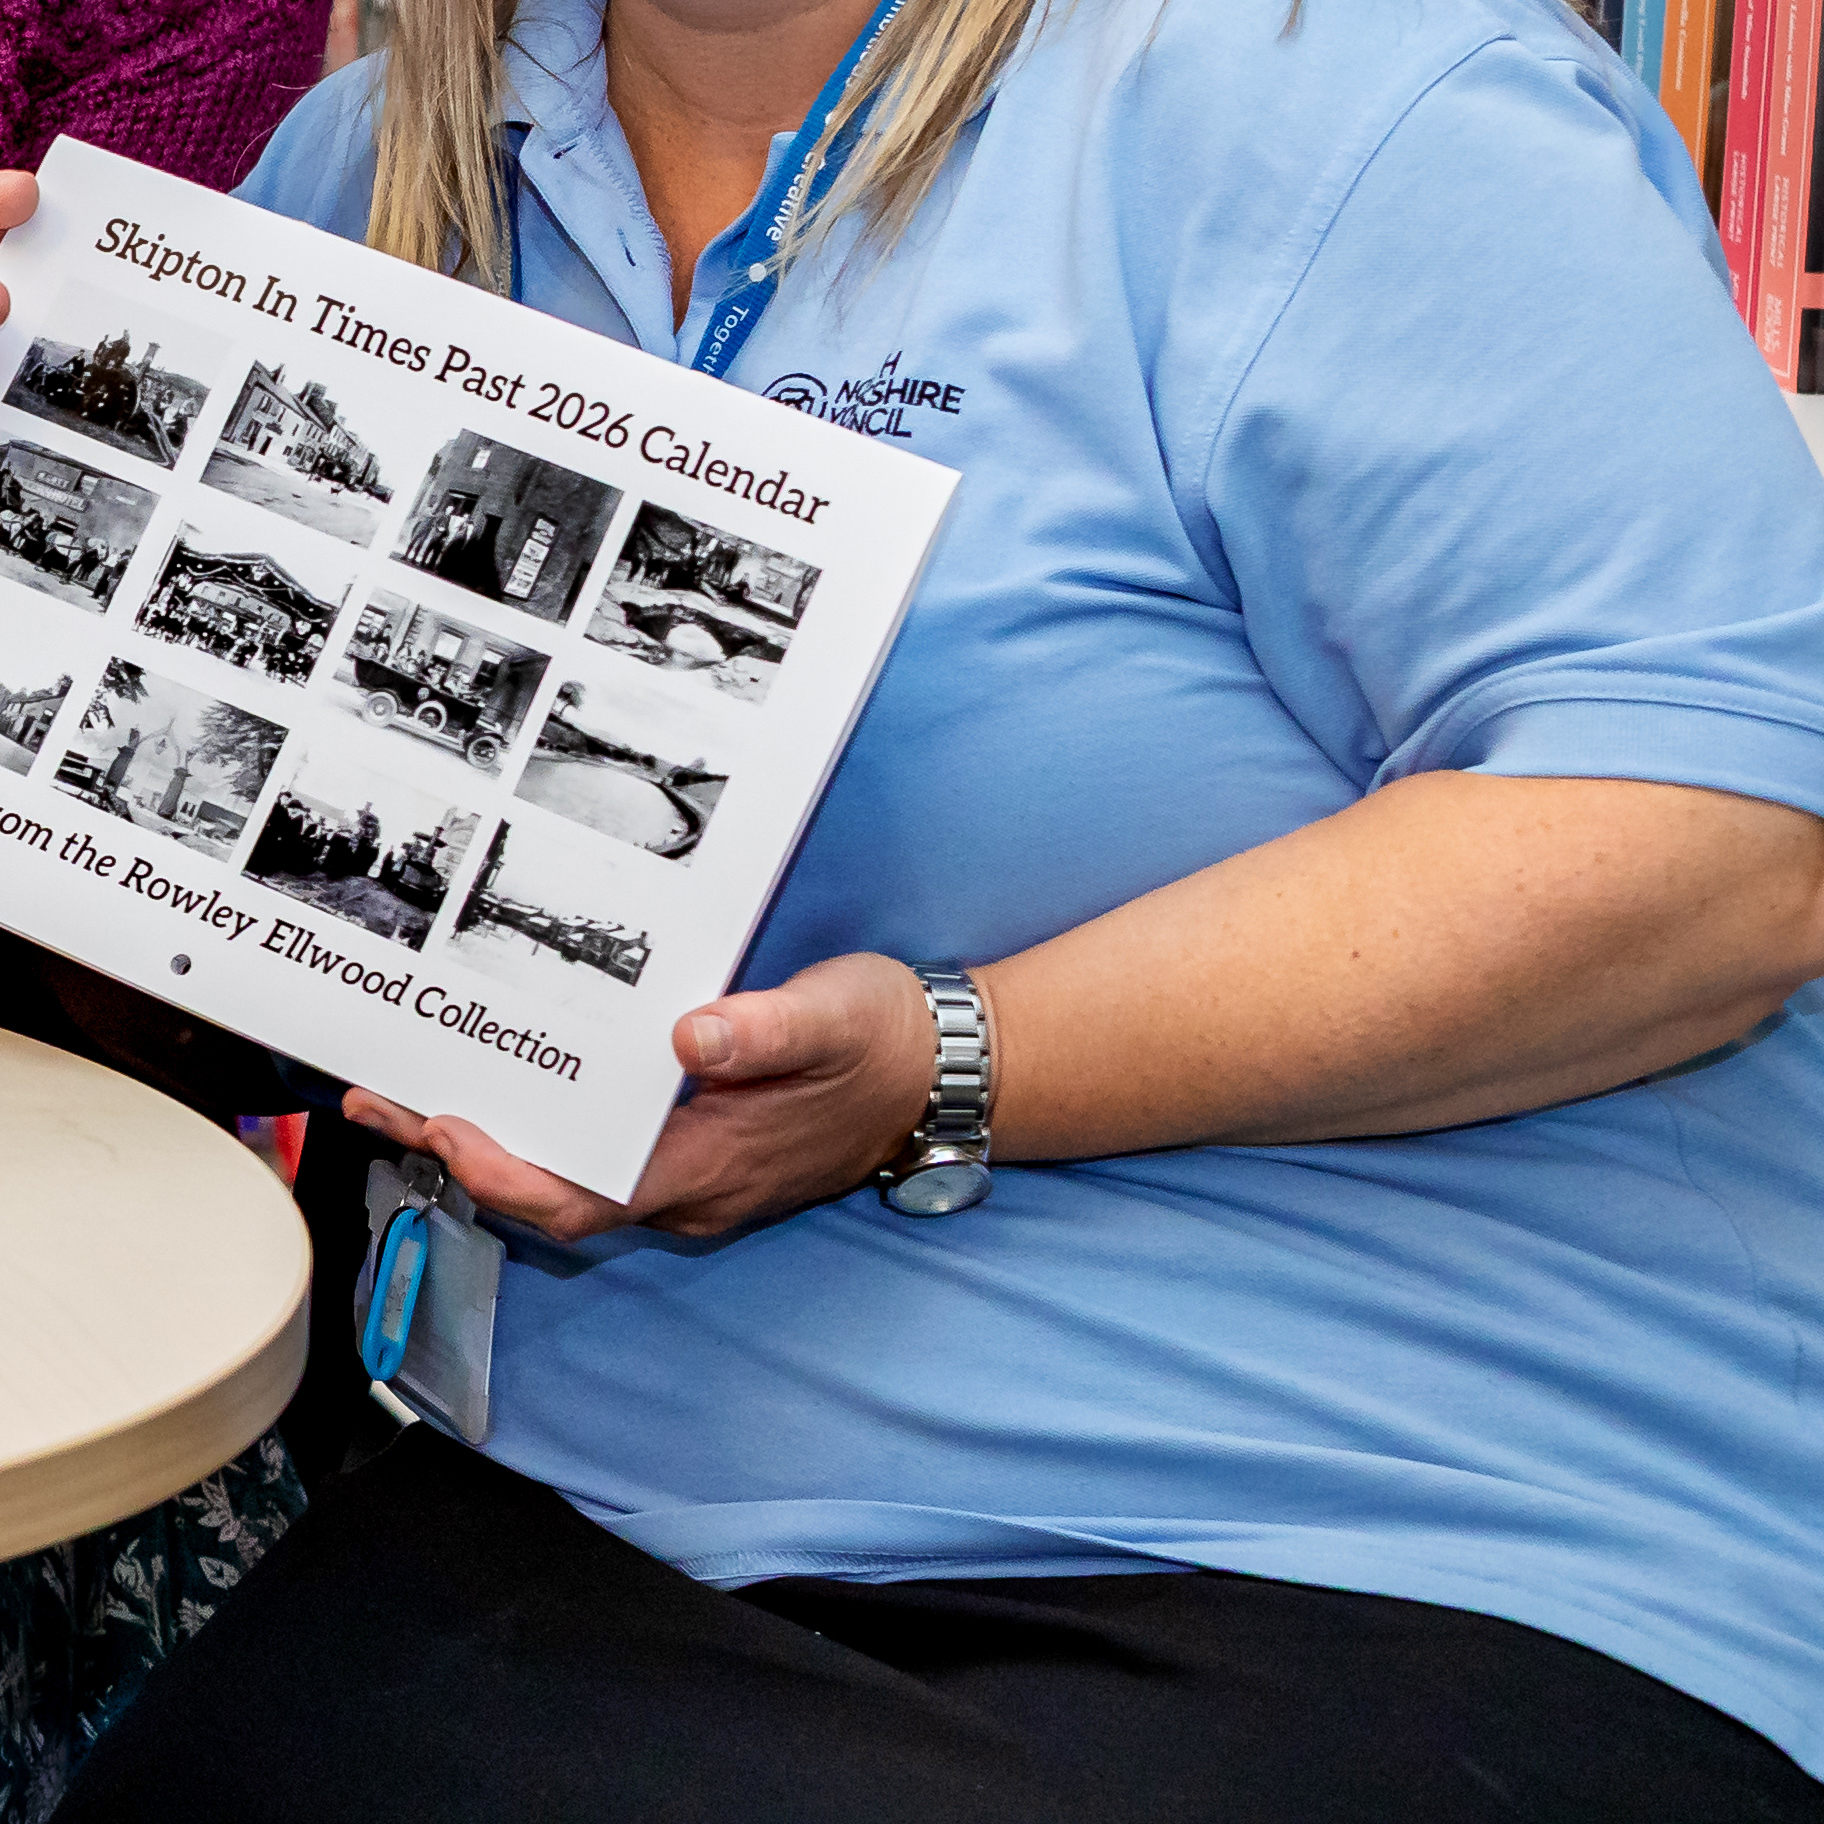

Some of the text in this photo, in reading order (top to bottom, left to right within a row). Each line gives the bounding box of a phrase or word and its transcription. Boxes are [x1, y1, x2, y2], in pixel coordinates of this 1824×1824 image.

[1744, 12, 1754, 42] Miss
[1785, 53, 1794, 82] with
[1783, 84, 1792, 115] Miss
[1727, 150, 1742, 244] LARGE PRINT
[1734, 152, 1749, 245] HISTORICAL
[1769, 174, 1783, 268] LARGE PRINT
[1775, 175, 1791, 270] HISTORICAL
[95, 217, 831, 525] Skipton In Times Past 2026 Calendar
[697, 303, 750, 376] Toget
[58, 831, 117, 878] the
[118, 856, 260, 942] Rowley
[258, 917, 415, 1007] Ellwood
[413, 985, 583, 1082] Collection
